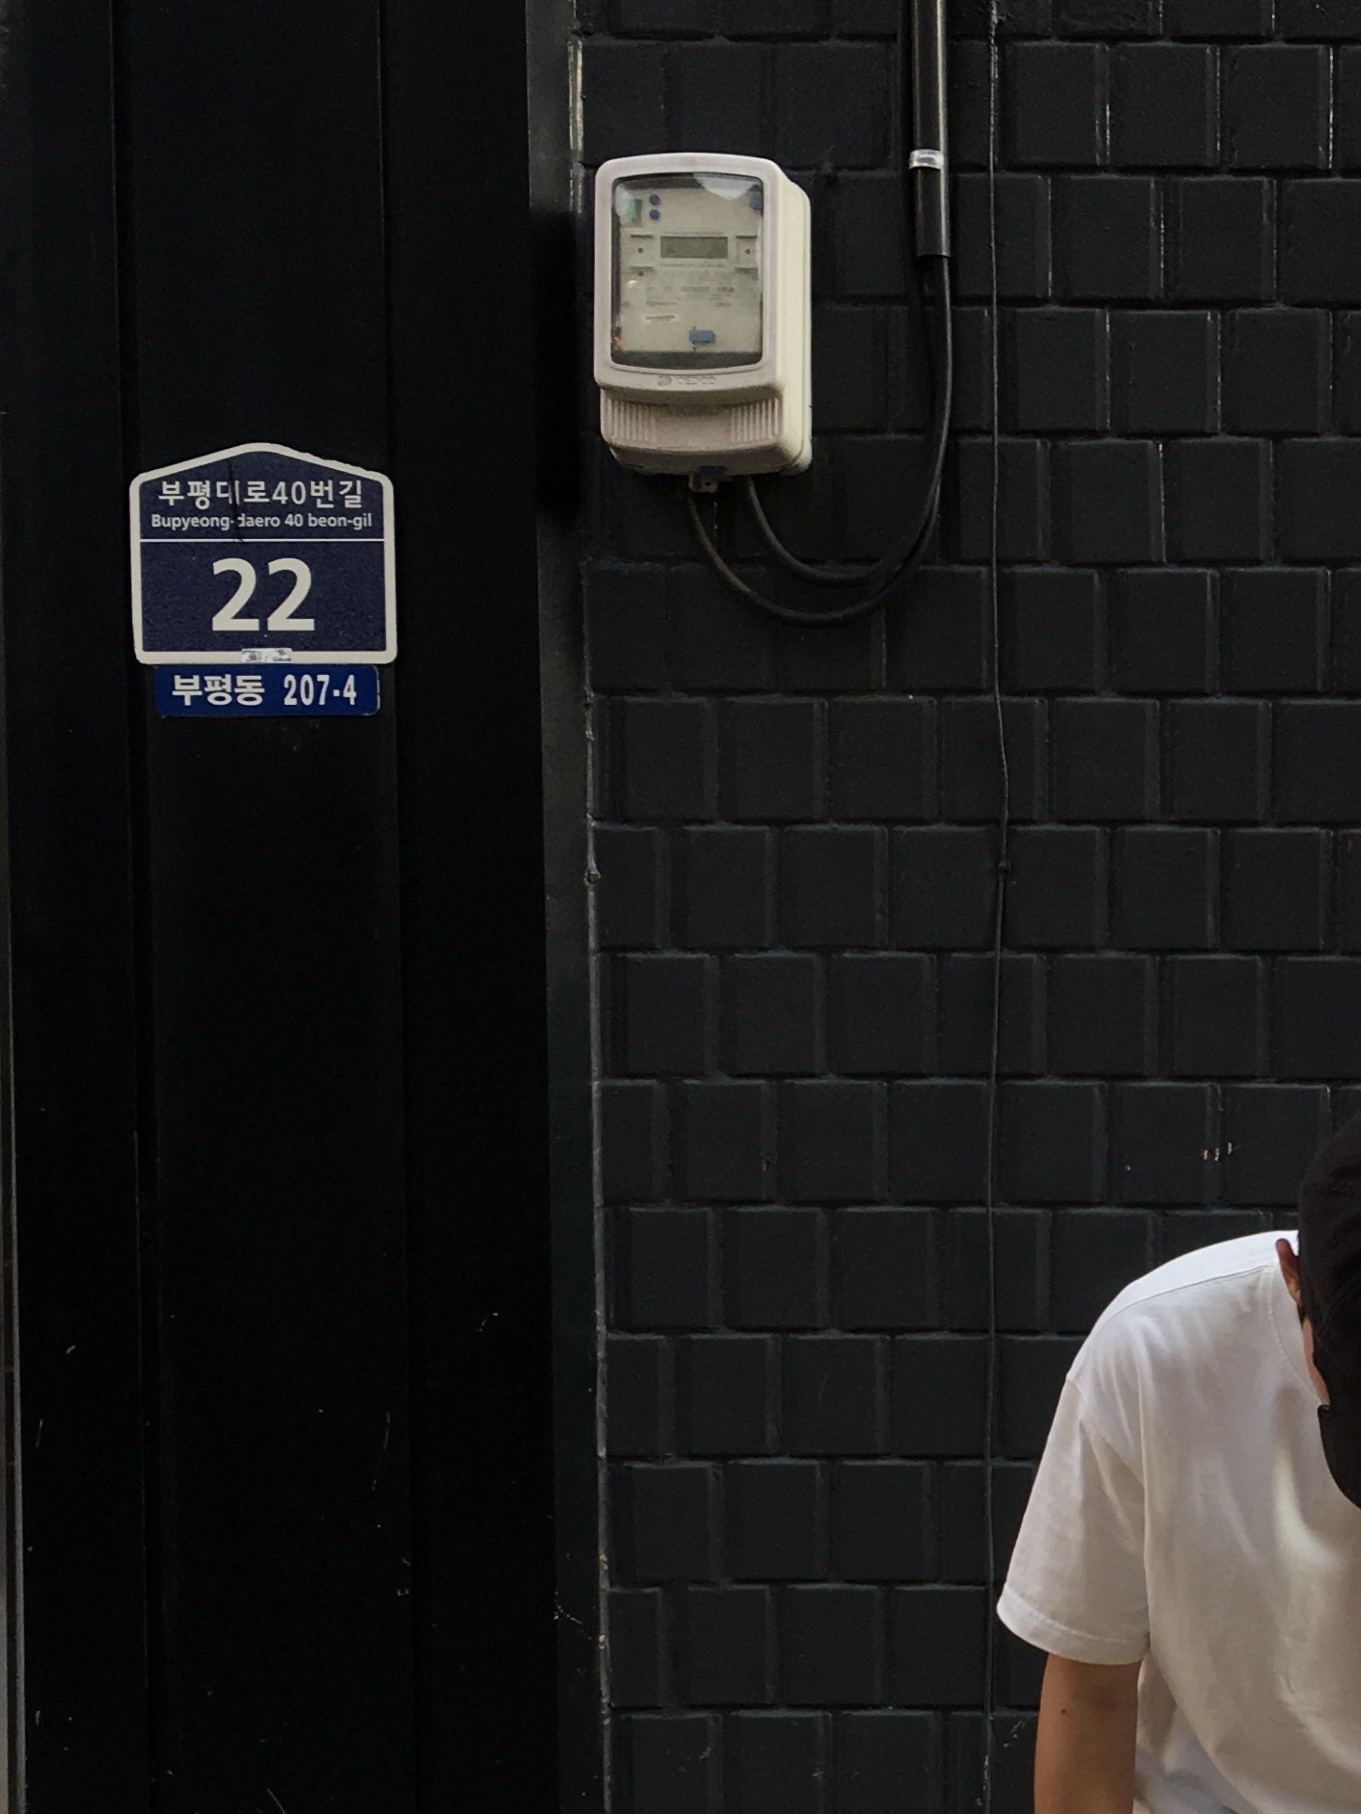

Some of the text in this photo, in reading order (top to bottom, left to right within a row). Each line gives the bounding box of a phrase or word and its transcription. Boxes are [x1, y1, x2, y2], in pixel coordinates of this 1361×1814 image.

[158, 479, 362, 510] 부평대로40번길
[285, 513, 304, 528] 40
[307, 513, 372, 531] beon-gil
[212, 557, 315, 631] 22
[172, 674, 357, 706] 부평동 207-4
